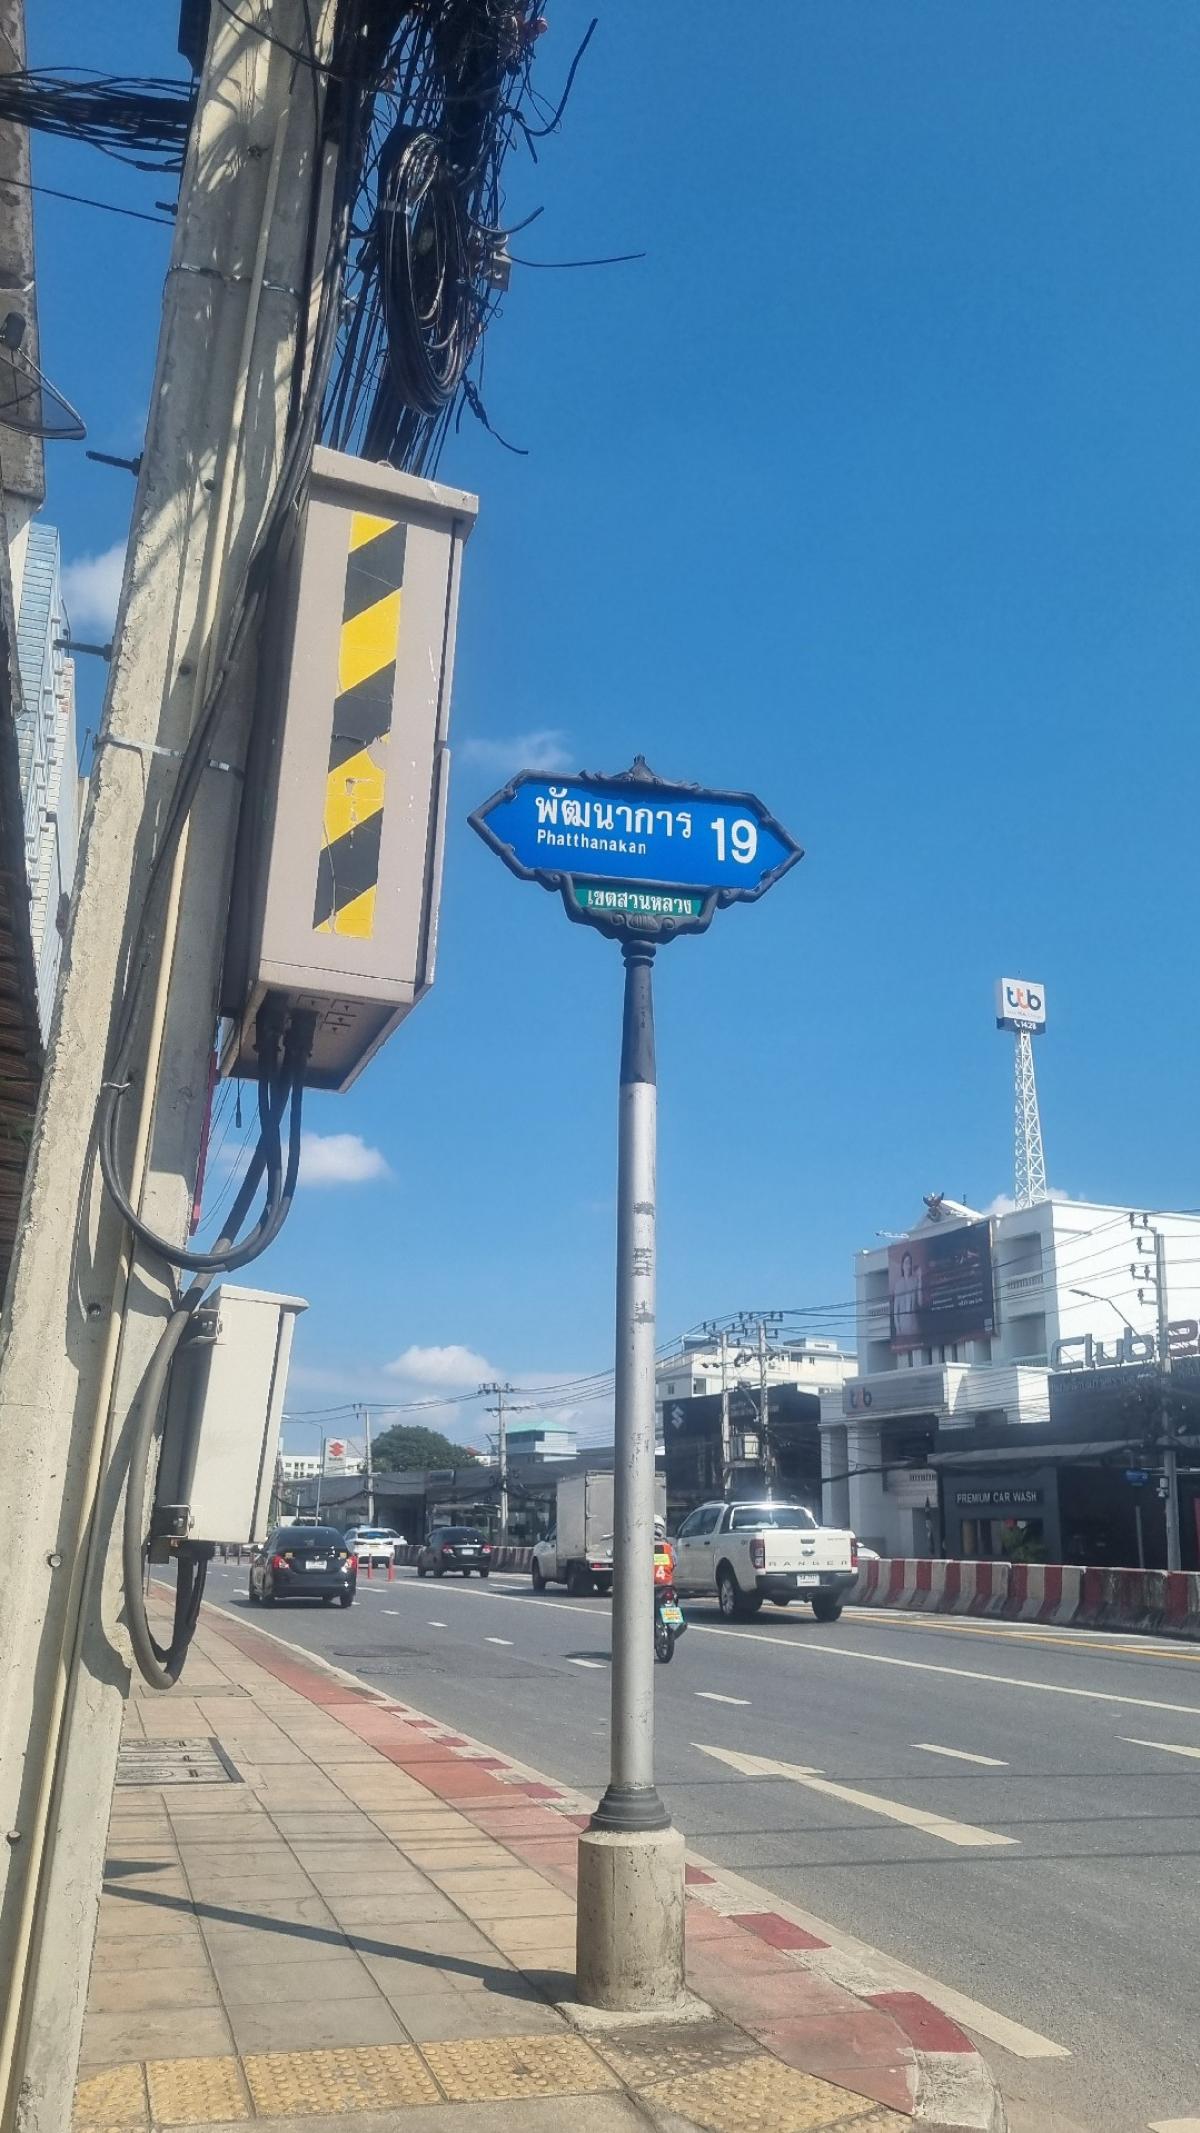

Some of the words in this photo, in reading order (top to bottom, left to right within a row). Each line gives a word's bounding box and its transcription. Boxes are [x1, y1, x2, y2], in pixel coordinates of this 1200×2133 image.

[535, 786, 692, 838] พัฒนาการ
[710, 817, 758, 864] 19
[536, 830, 647, 855] Phatthanakan
[587, 889, 693, 915] เขตสวนหลวง
[1006, 986, 1042, 1011] ttb
[1051, 1326, 1155, 1372] Club
[956, 1491, 991, 1504] PREMIUM
[993, 1491, 1011, 1503] CAR
[1013, 1490, 1038, 1503] WASH
